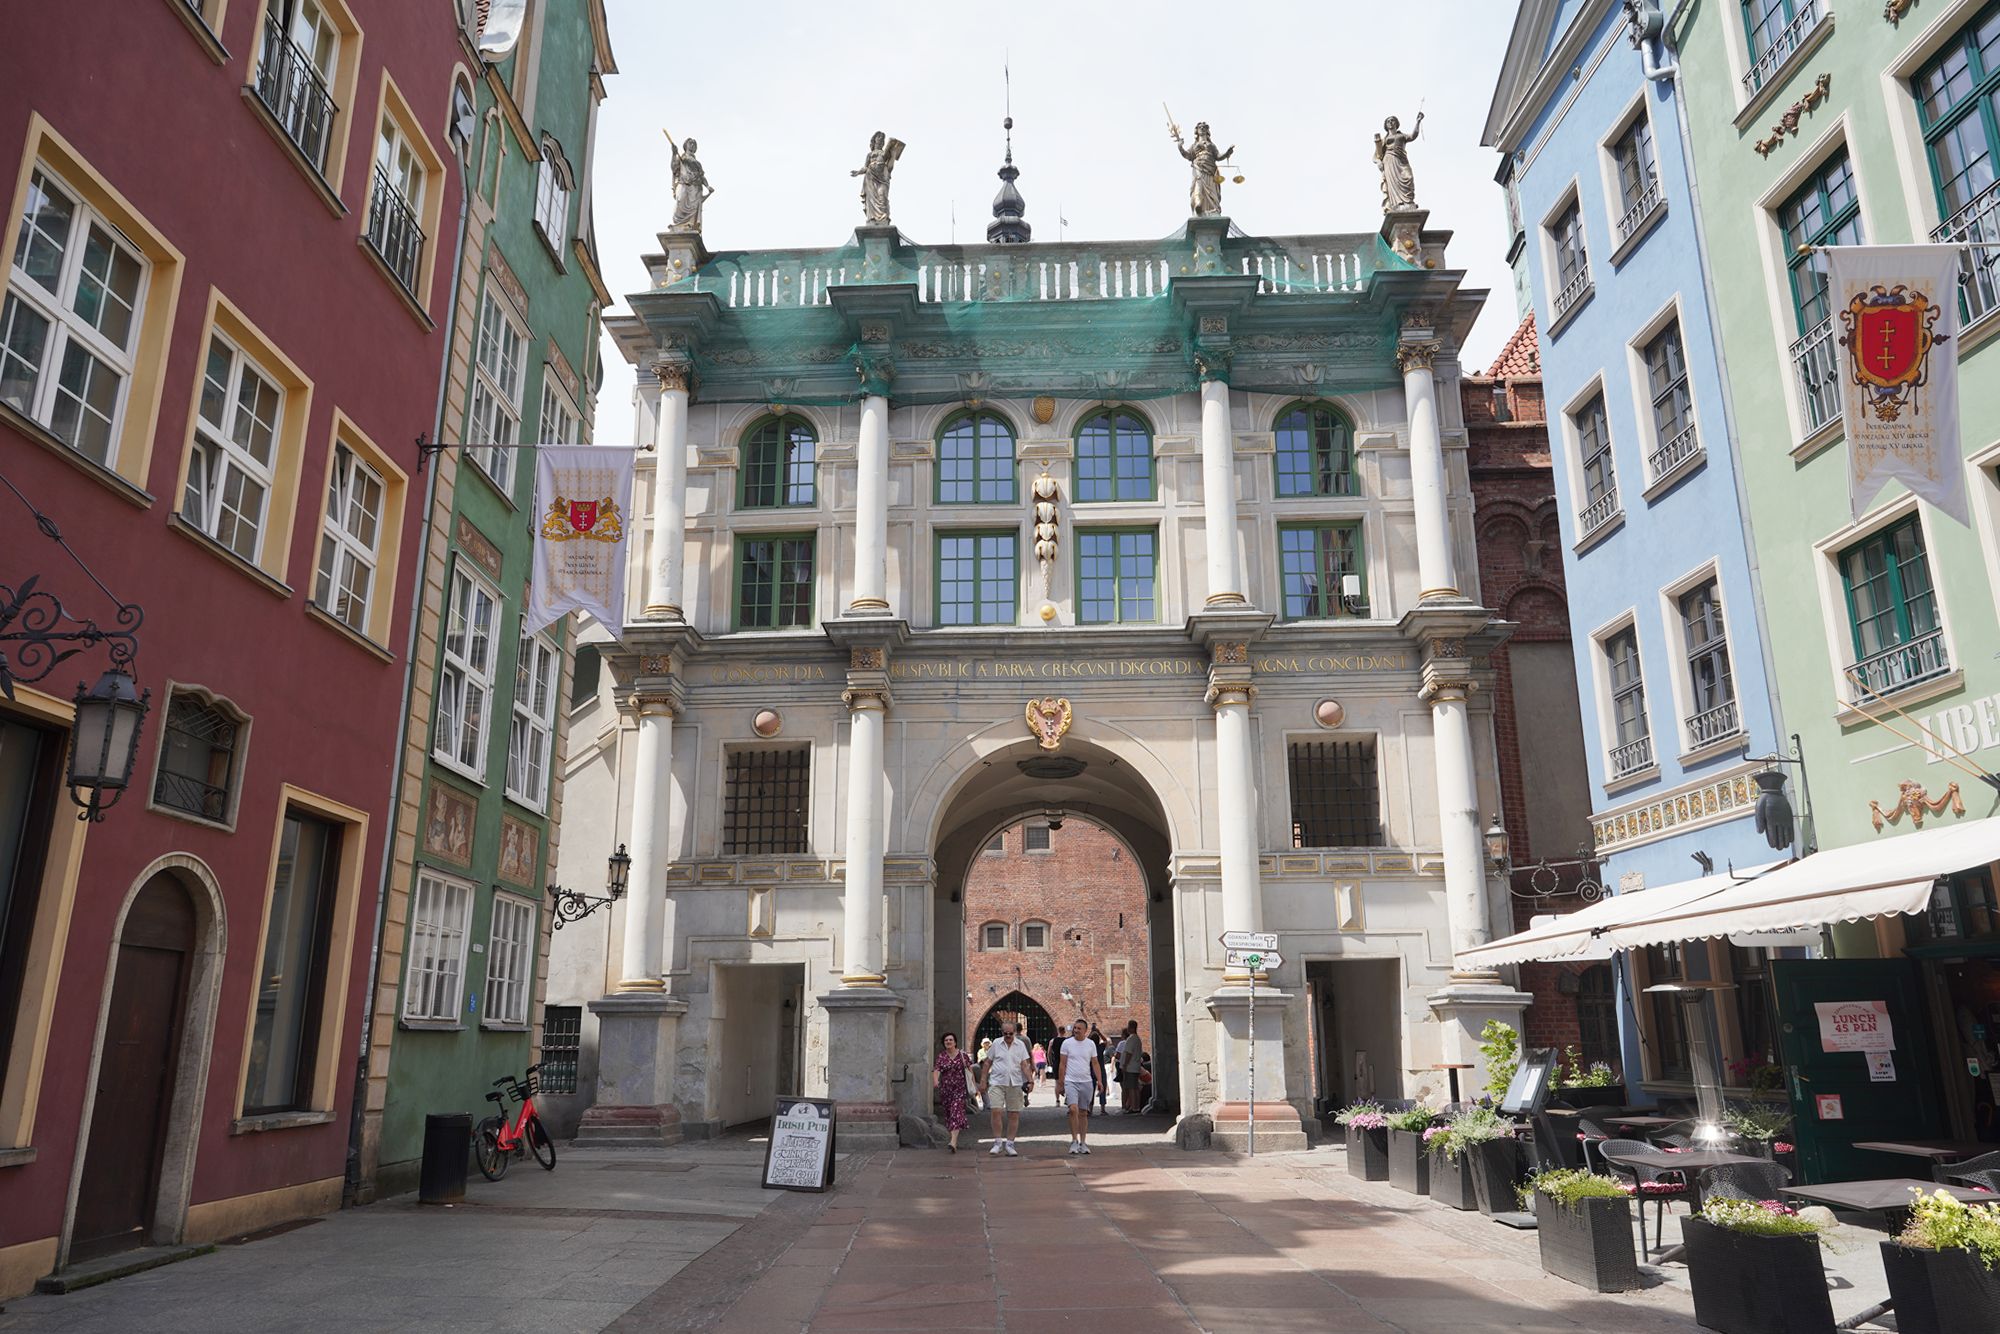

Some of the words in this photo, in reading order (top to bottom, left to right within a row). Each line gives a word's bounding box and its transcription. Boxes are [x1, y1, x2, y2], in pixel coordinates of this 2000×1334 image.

[712, 664, 825, 682] CONCORDIA
[1041, 661, 1117, 677] CRESCVNT
[1120, 660, 1205, 675] DISCORDIA
[1308, 655, 1407, 672] CONCIDVNT
[1832, 1014, 1877, 1024] LUNCH
[1835, 1024, 1849, 1032] 45
[1853, 1023, 1877, 1032] PLN
[777, 1119, 805, 1130] IRISH
[808, 1120, 828, 1132] PUB
